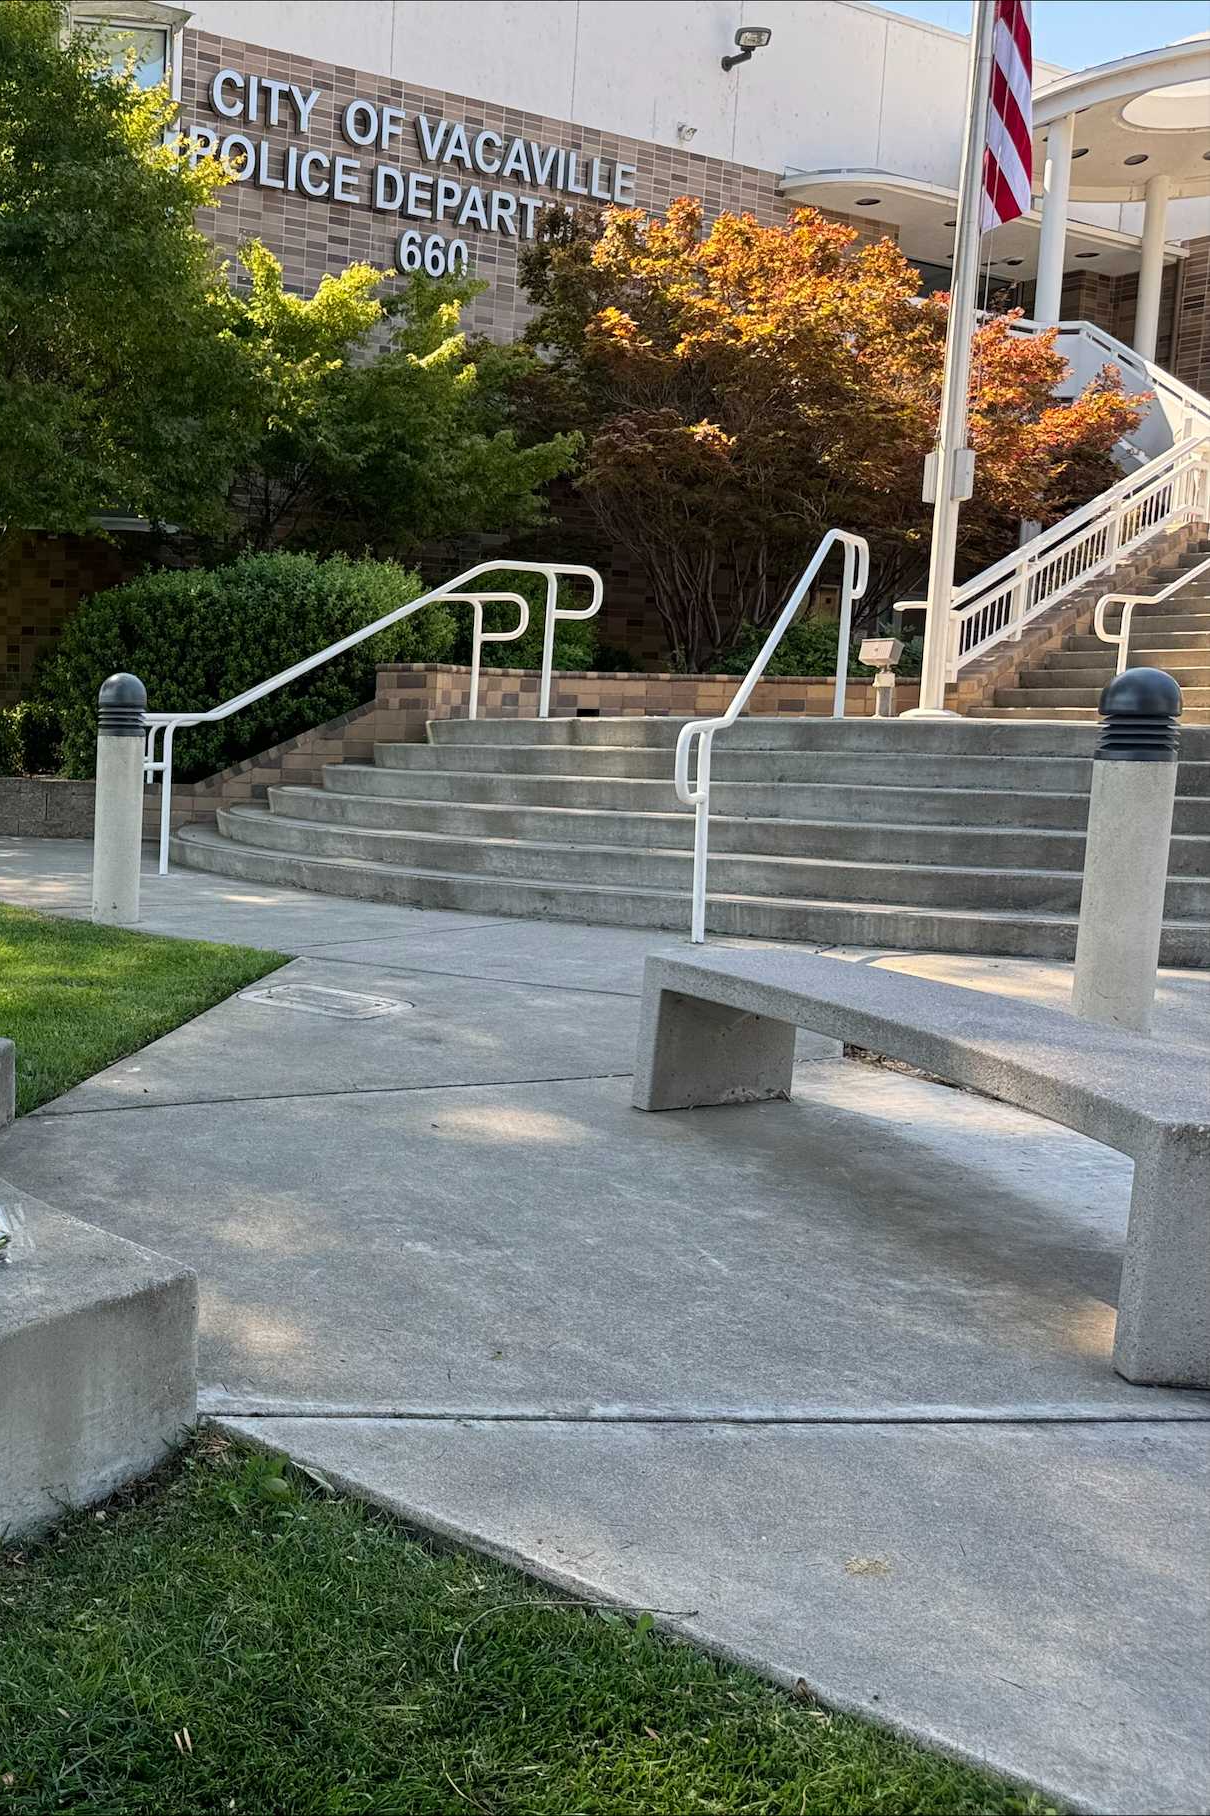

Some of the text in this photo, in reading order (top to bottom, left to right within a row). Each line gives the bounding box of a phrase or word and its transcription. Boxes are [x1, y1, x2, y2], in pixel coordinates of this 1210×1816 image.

[188, 125, 575, 240] POLICE DEPART
[210, 68, 637, 206] CITY OF VACAVILLE
[399, 229, 469, 277] 660
